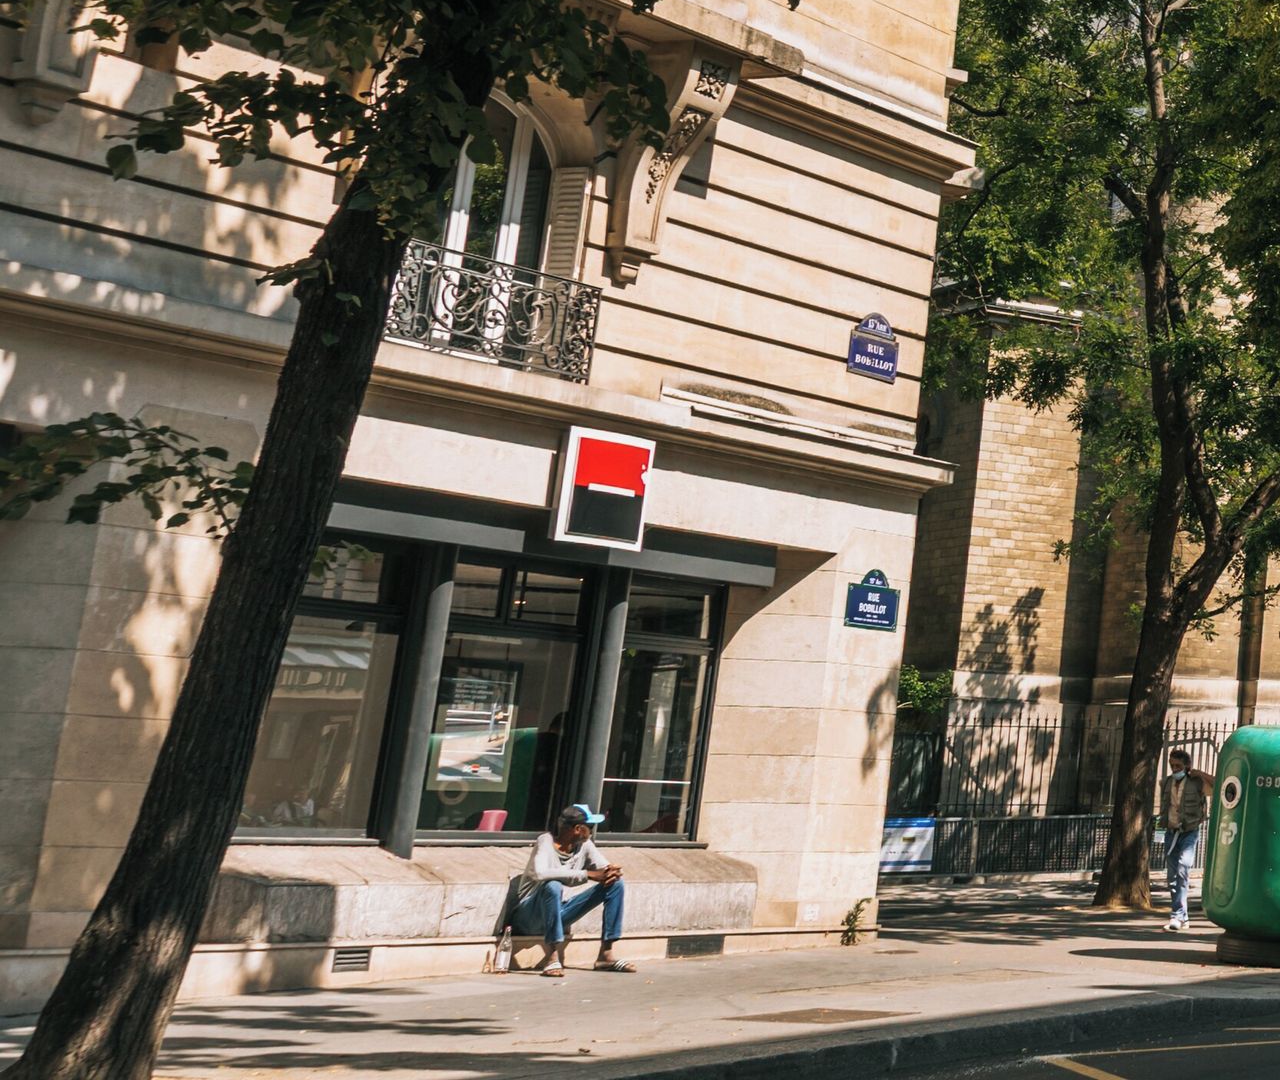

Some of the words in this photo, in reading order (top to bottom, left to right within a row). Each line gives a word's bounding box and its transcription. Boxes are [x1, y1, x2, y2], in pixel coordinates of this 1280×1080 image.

[867, 344, 884, 355] RUE
[855, 354, 893, 371] BOBILLOT
[867, 592, 880, 603] RUE
[859, 602, 886, 614] BOBILLOT
